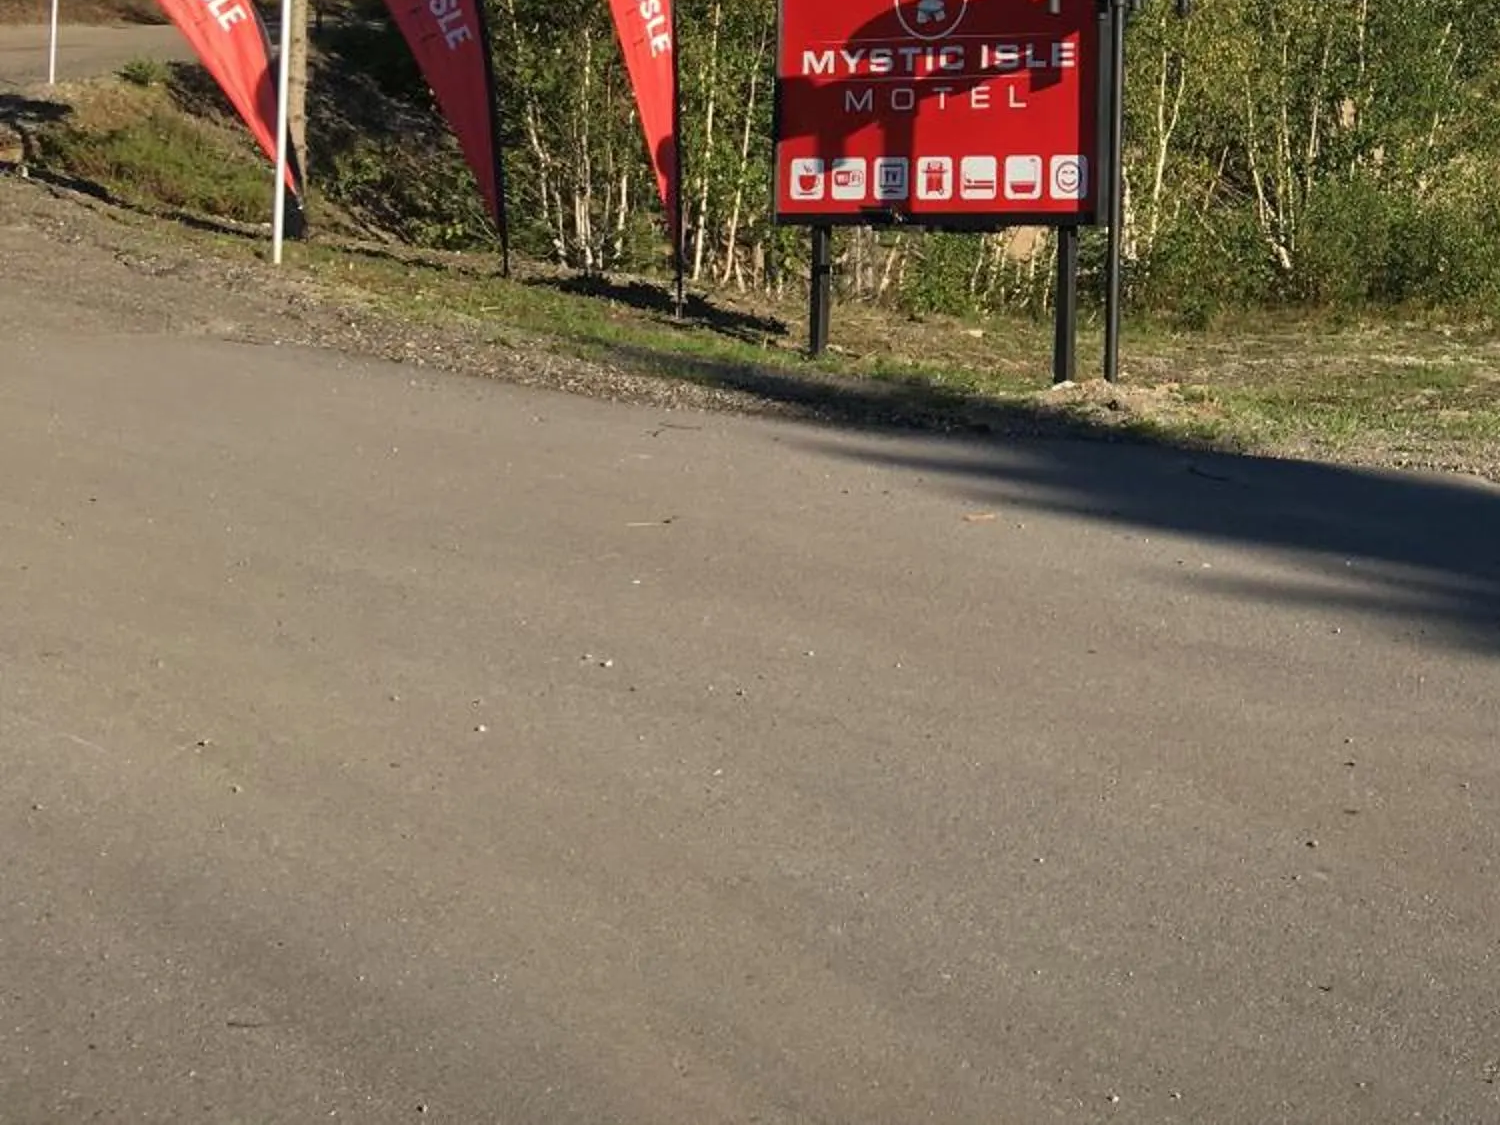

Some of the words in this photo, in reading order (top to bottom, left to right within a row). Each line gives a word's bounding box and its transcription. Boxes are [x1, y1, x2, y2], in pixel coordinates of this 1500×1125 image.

[802, 44, 964, 75] MYSTIC
[981, 42, 1076, 70] ISLE
[845, 85, 1027, 112] MOTEL
